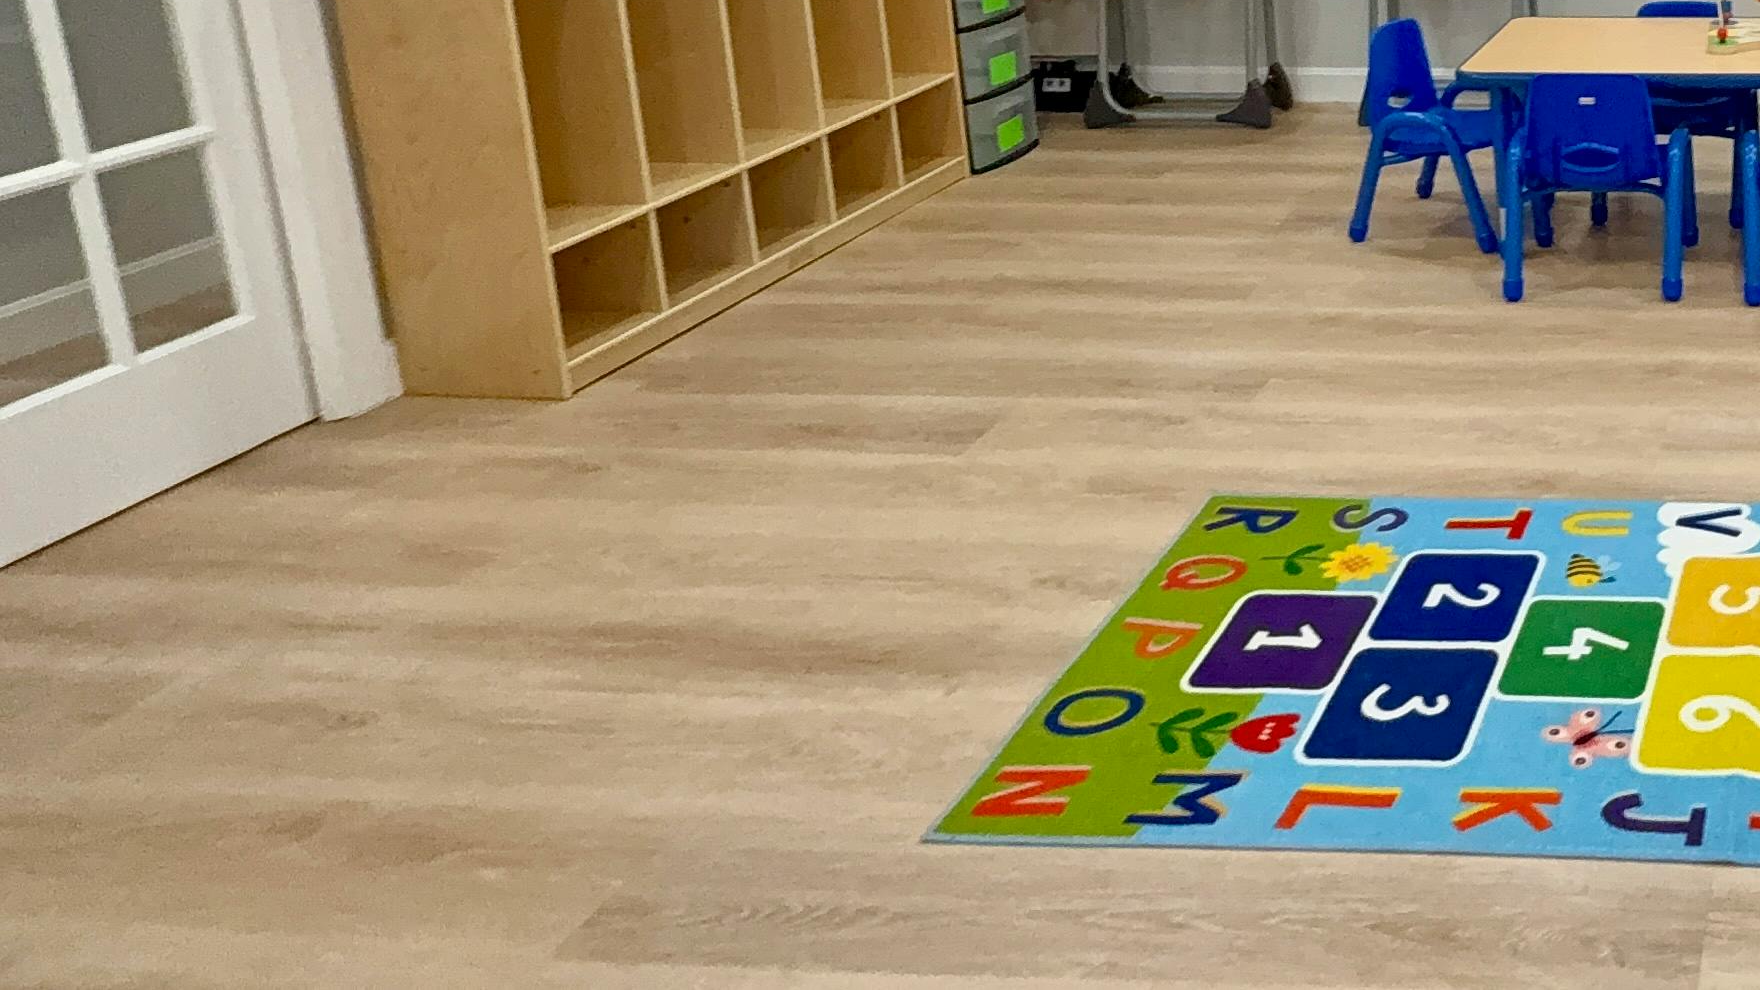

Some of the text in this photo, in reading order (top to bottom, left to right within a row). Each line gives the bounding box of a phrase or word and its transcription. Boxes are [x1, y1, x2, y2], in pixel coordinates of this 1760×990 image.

[1204, 507, 1299, 534] R
[1330, 504, 1408, 532] S
[1444, 508, 1533, 540] T
[1562, 510, 1633, 536] U
[1676, 509, 1742, 538] V
[1159, 554, 1248, 591] Q
[1422, 582, 1501, 609] 2
[1121, 617, 1203, 659] P
[1243, 624, 1322, 650] 1
[1542, 627, 1630, 660] 4
[1044, 686, 1145, 737] O
[1361, 683, 1450, 722] 3
[971, 765, 1095, 817] N
[1122, 769, 1250, 826] M
[1274, 784, 1402, 830] L
[1451, 787, 1563, 832] K
[1601, 791, 1707, 846] J
